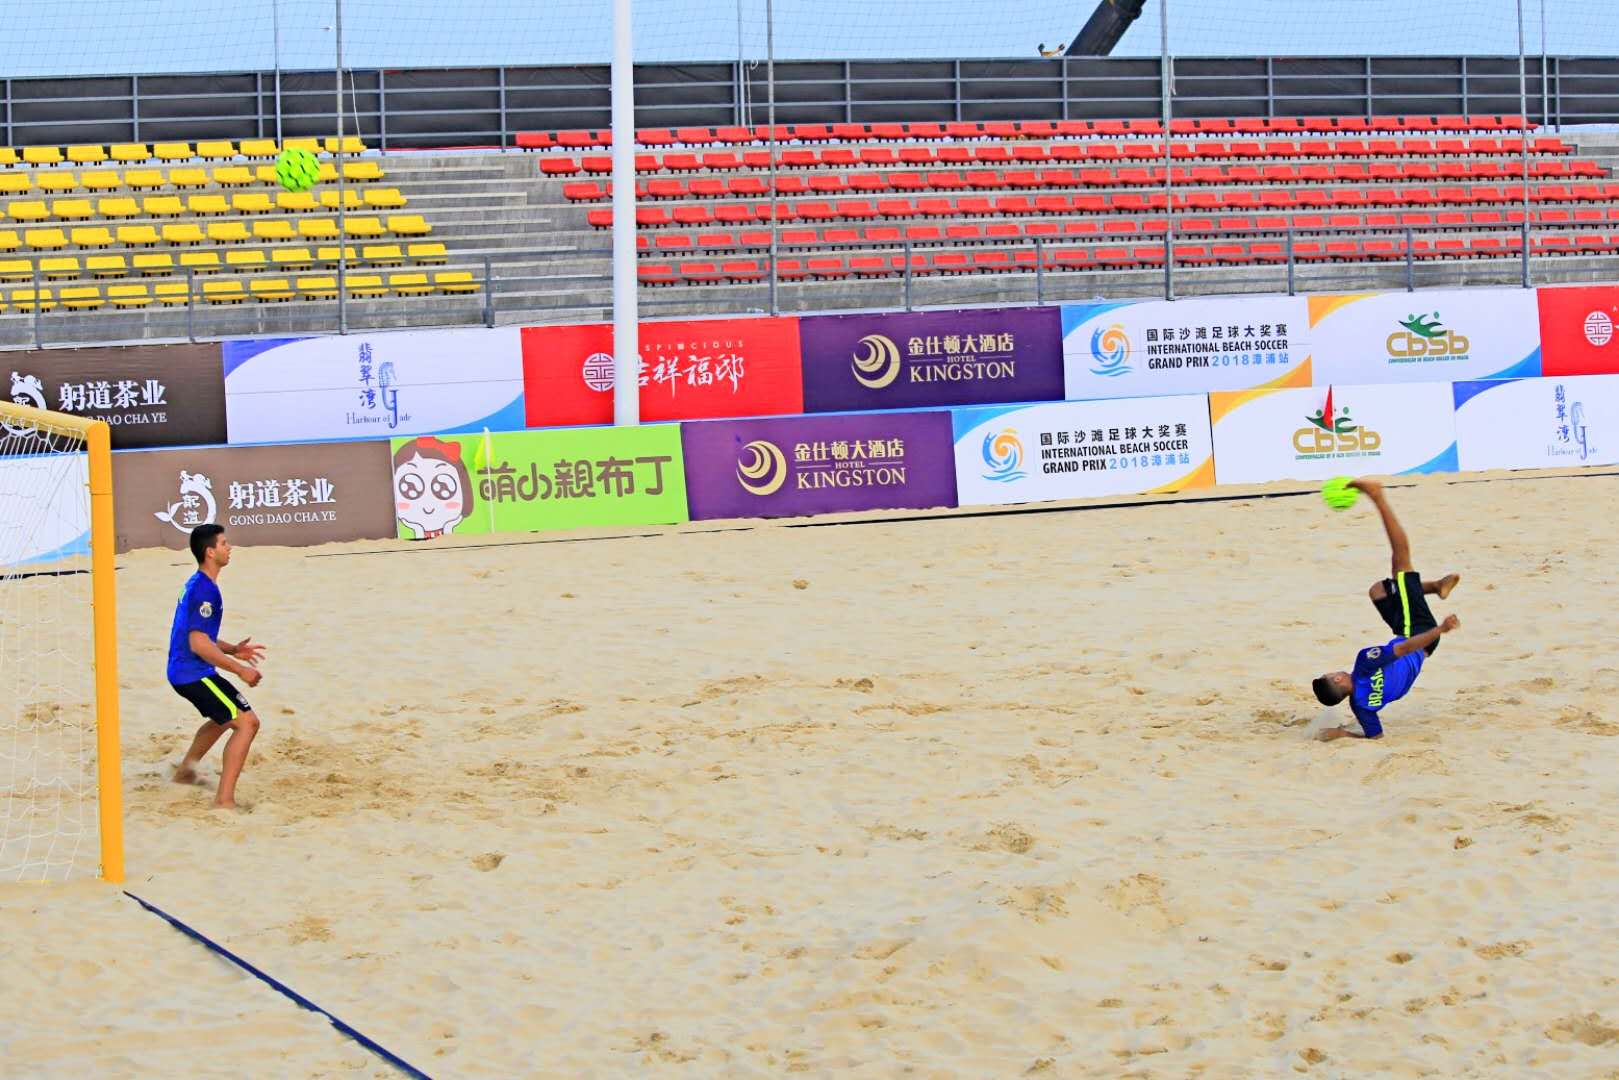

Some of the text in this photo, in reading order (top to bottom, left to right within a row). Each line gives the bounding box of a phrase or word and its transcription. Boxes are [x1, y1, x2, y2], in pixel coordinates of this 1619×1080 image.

[1146, 323, 1288, 342] 国际沙滩足球大奖赛
[907, 332, 1015, 356] 金仕顿大酒店
[1147, 339, 1288, 355] INTERNATIONAL BEACH SOCCER
[946, 355, 976, 364] HOTEL
[1148, 357, 1183, 369] GRAND
[1186, 355, 1210, 368] PRIX
[909, 360, 1016, 383] KINGSTON
[58, 379, 168, 412] 躬道茶业
[124, 413, 150, 424] CHA
[150, 412, 168, 424] YE
[1040, 423, 1187, 446] 国际沙滩足球大奖赛
[794, 439, 905, 462] 金仕顿大酒店
[1041, 440, 1188, 460] INTERNATIONAL BEACH SOCCER
[835, 461, 865, 470] HOTEL
[1043, 460, 1079, 474] GRAND
[1082, 459, 1107, 472] PRIX
[797, 467, 906, 489] KINGSTON
[228, 478, 337, 509] 躬道茶业
[229, 511, 337, 526] GONG DAO CHA YE
